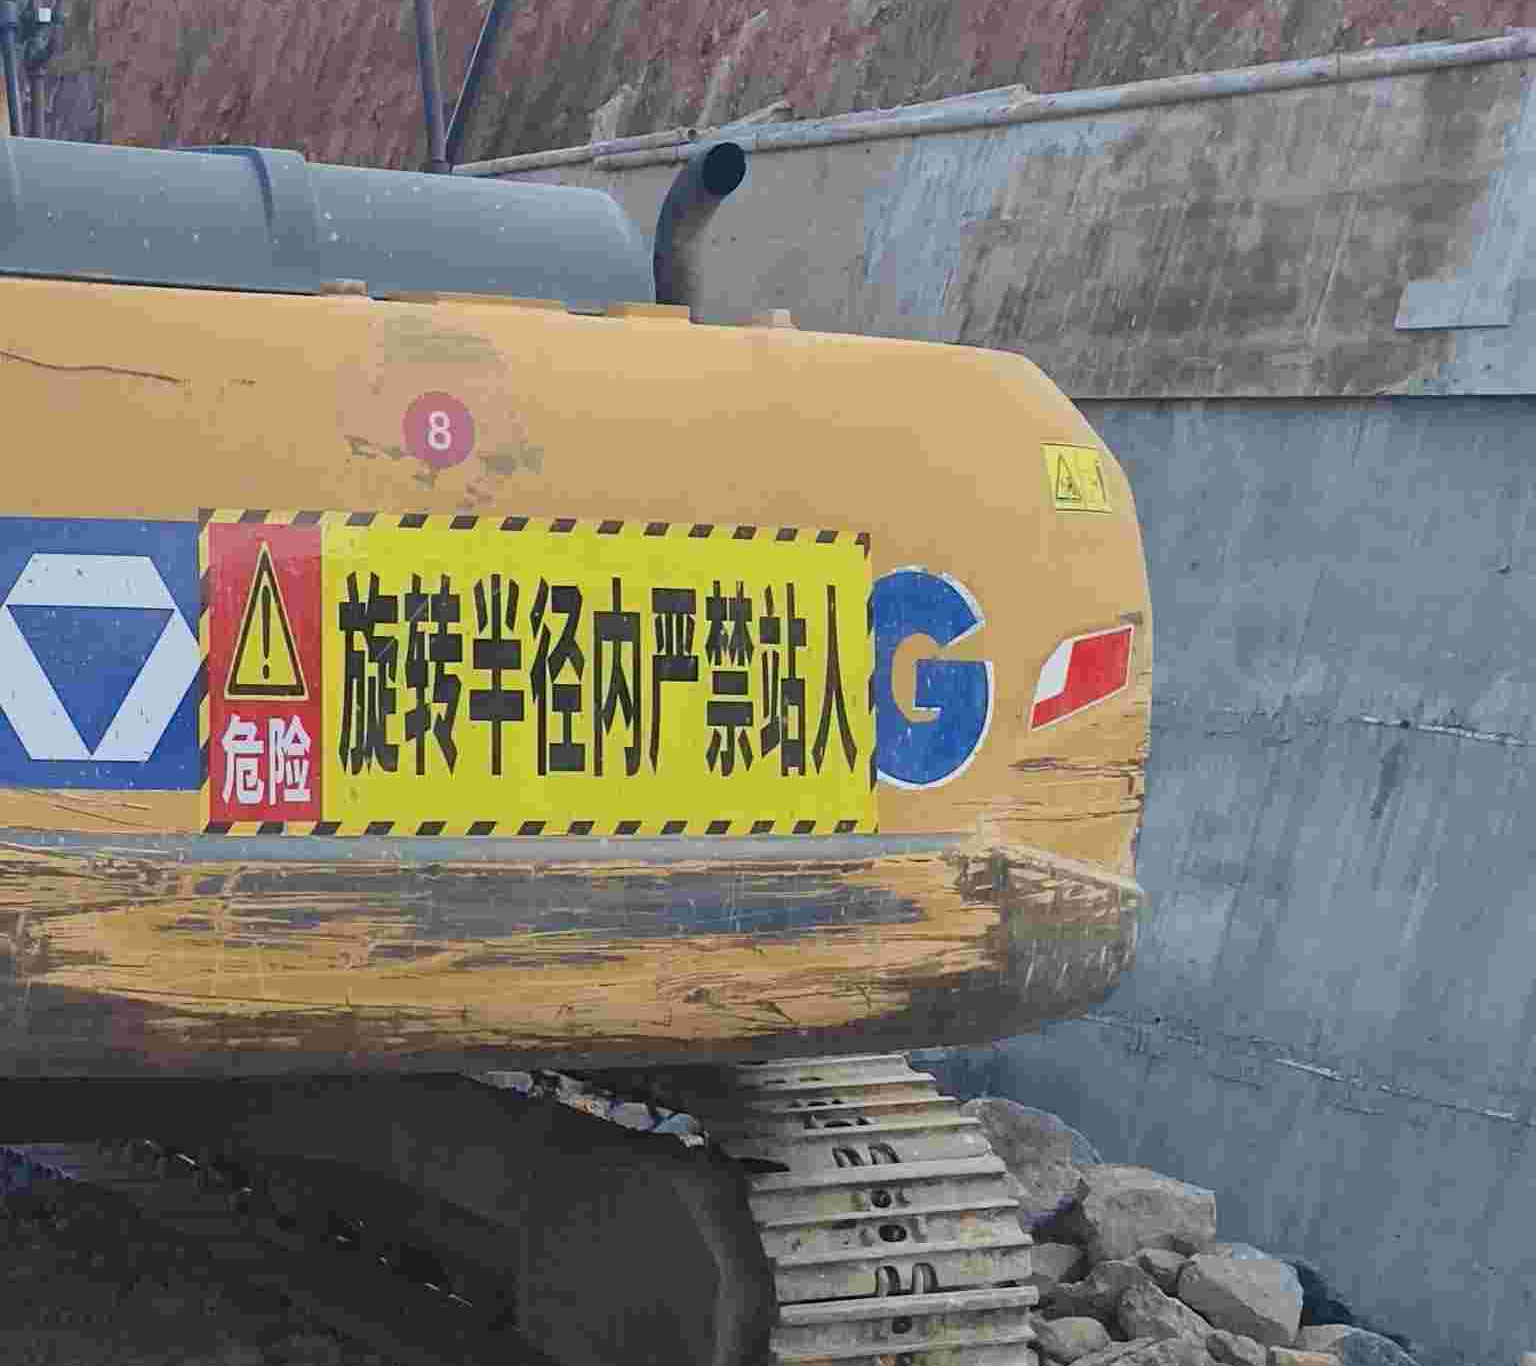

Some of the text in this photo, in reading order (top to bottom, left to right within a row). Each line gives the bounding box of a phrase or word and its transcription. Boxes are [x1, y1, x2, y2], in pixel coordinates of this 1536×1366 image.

[427, 411, 451, 450] 8
[337, 571, 859, 777] 旋转半径内严禁站人
[221, 714, 311, 806] 危险
